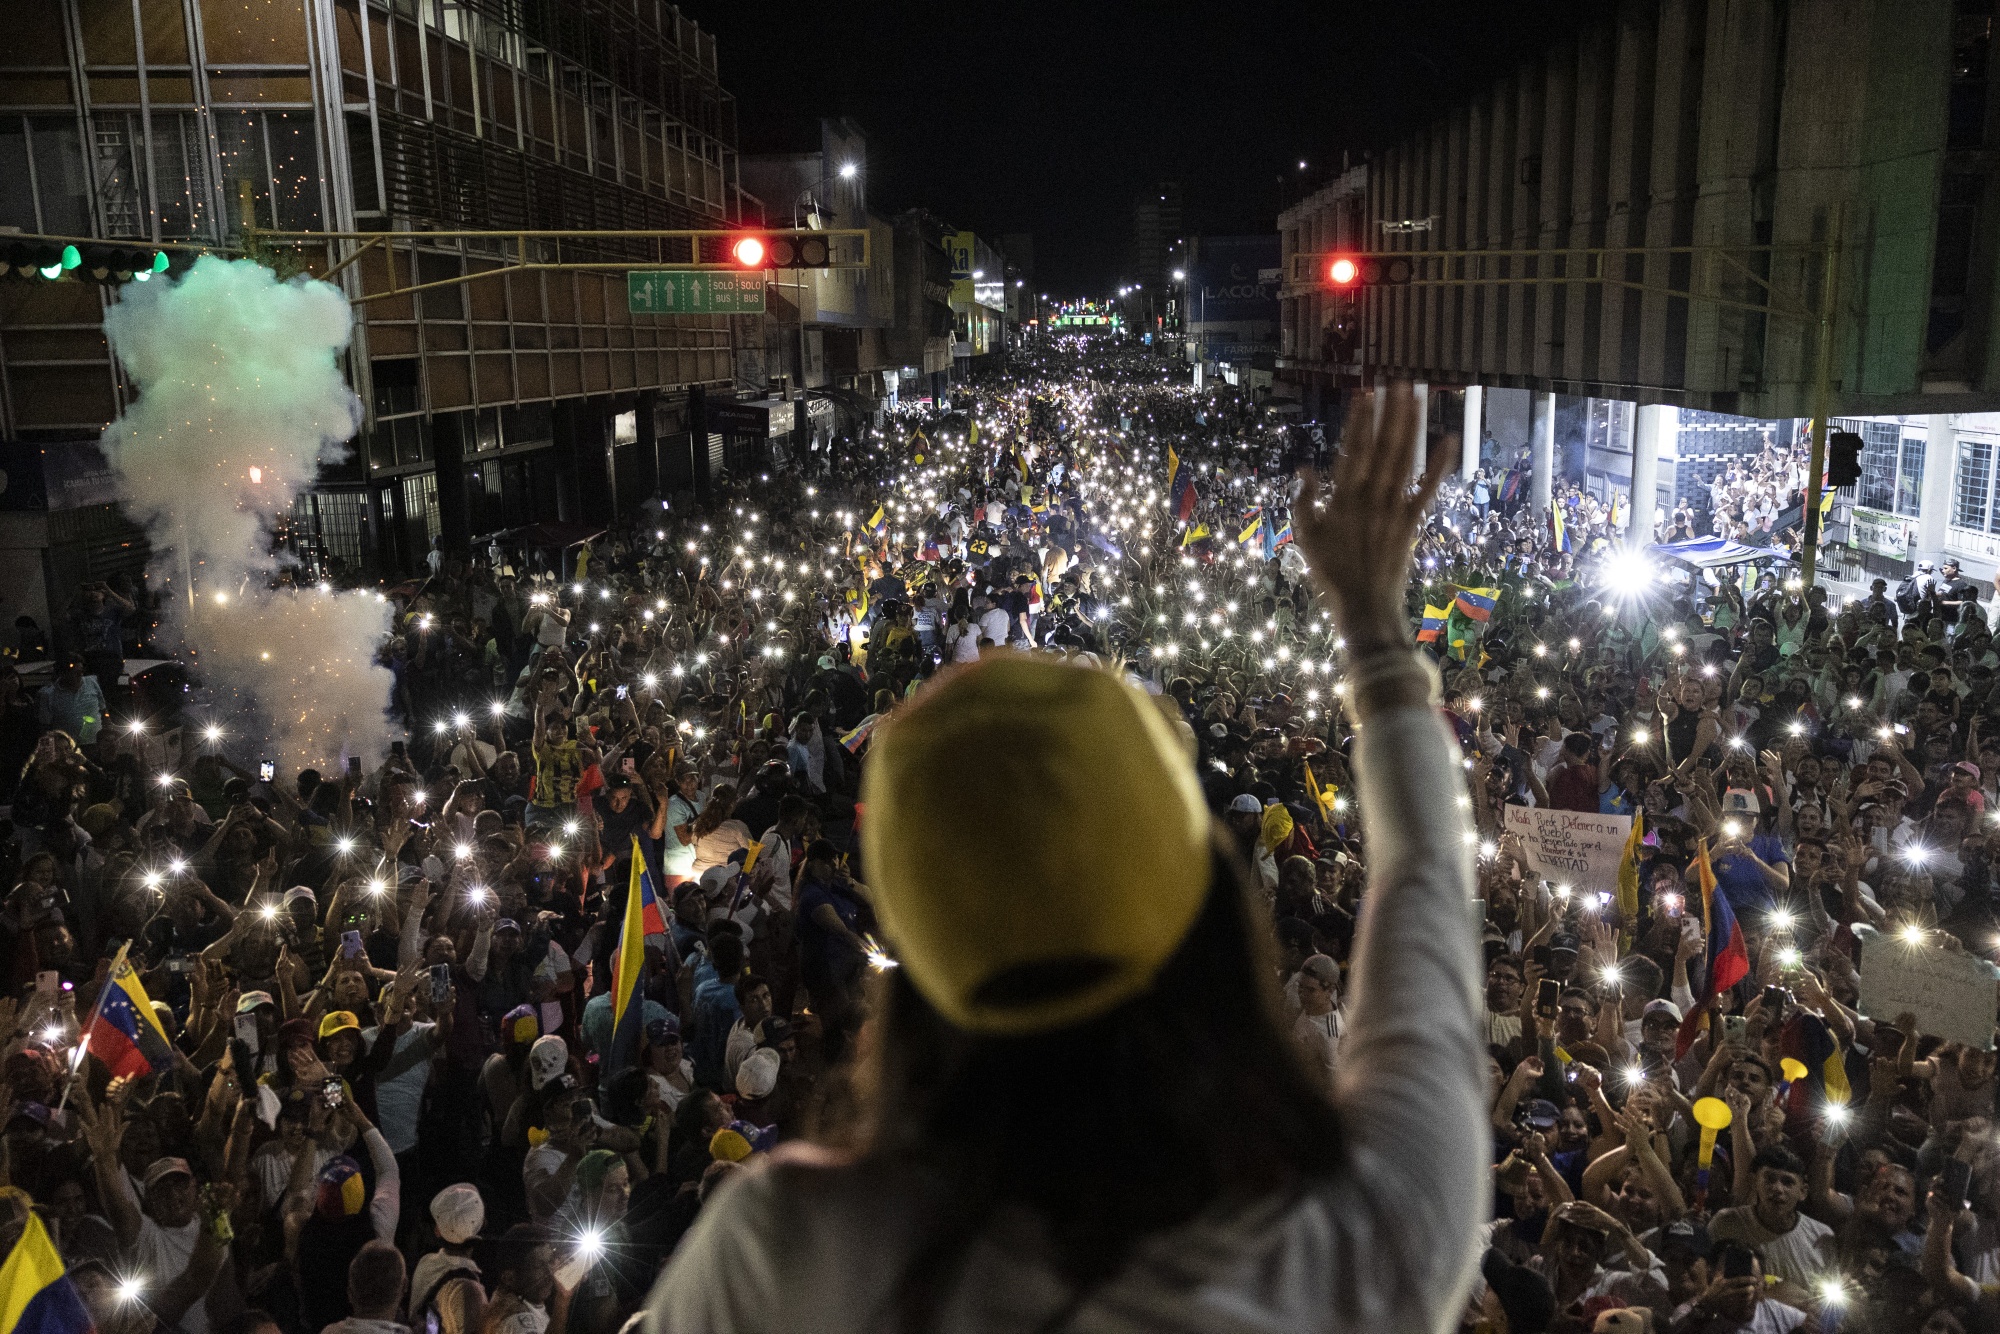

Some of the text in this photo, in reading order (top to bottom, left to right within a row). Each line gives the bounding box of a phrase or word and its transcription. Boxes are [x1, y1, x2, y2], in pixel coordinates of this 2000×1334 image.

[714, 281, 734, 290] SOLO
[741, 281, 761, 290] SOLO
[716, 294, 731, 303] BUS
[744, 294, 759, 303] BUS
[1205, 284, 1270, 301] LACOR
[1224, 344, 1277, 355] FARMACIA
[970, 539, 988, 555] 23
[1508, 809, 1532, 826] Nada
[1534, 811, 1556, 827] Puede
[1607, 825, 1618, 835] un
[1538, 825, 1572, 840] Pueblo
[1536, 852, 1589, 872] LIBERTAD
